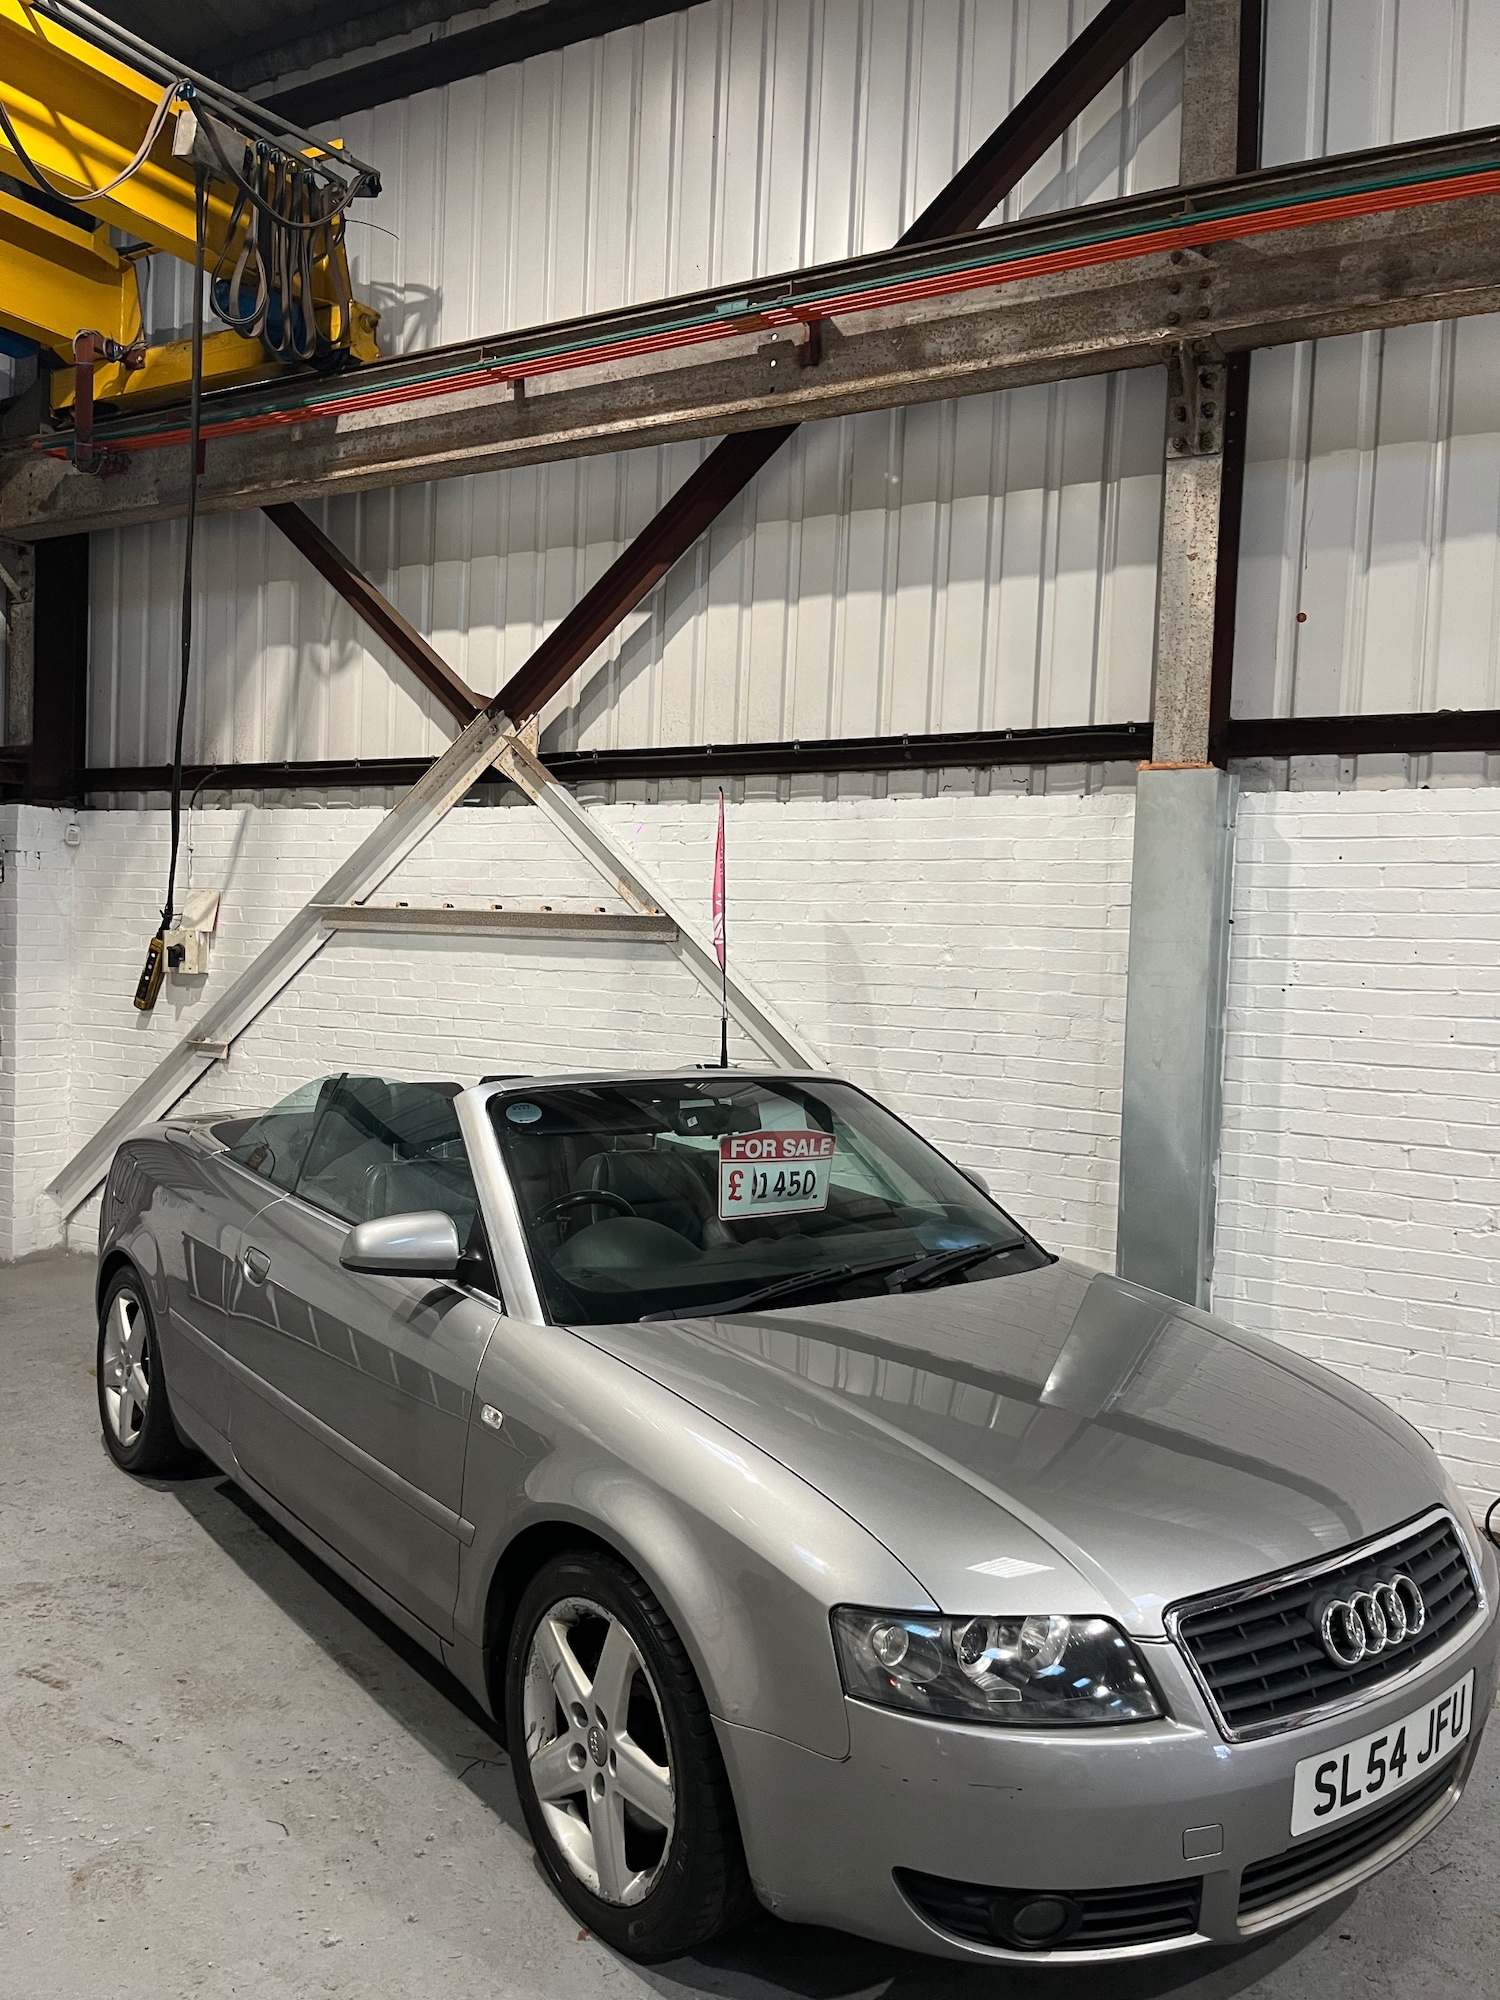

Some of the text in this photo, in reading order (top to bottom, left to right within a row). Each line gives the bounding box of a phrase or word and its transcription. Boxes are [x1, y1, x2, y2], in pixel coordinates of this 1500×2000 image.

[731, 1138, 832, 1158] FOR SALE
[1313, 1684, 1466, 1816] SL54 JFU
